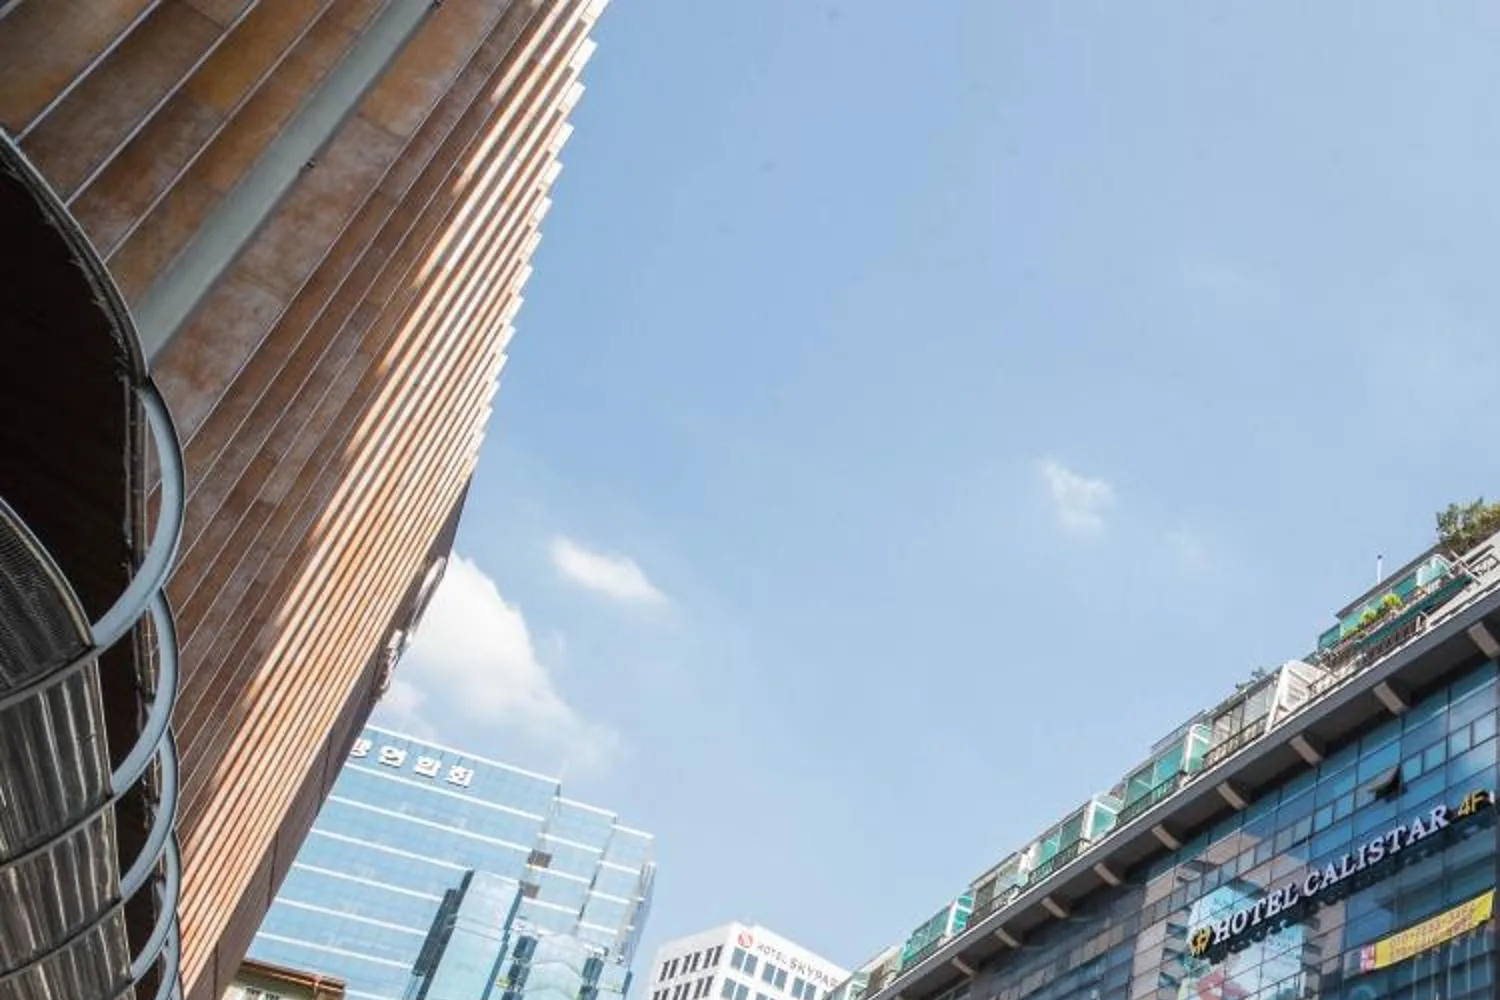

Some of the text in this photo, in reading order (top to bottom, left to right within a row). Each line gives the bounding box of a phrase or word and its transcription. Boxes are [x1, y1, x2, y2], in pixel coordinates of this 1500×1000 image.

[1212, 883, 1300, 944] HOTEL
[1302, 804, 1451, 897] CALISTAR
[757, 944, 788, 965] HOTEL
